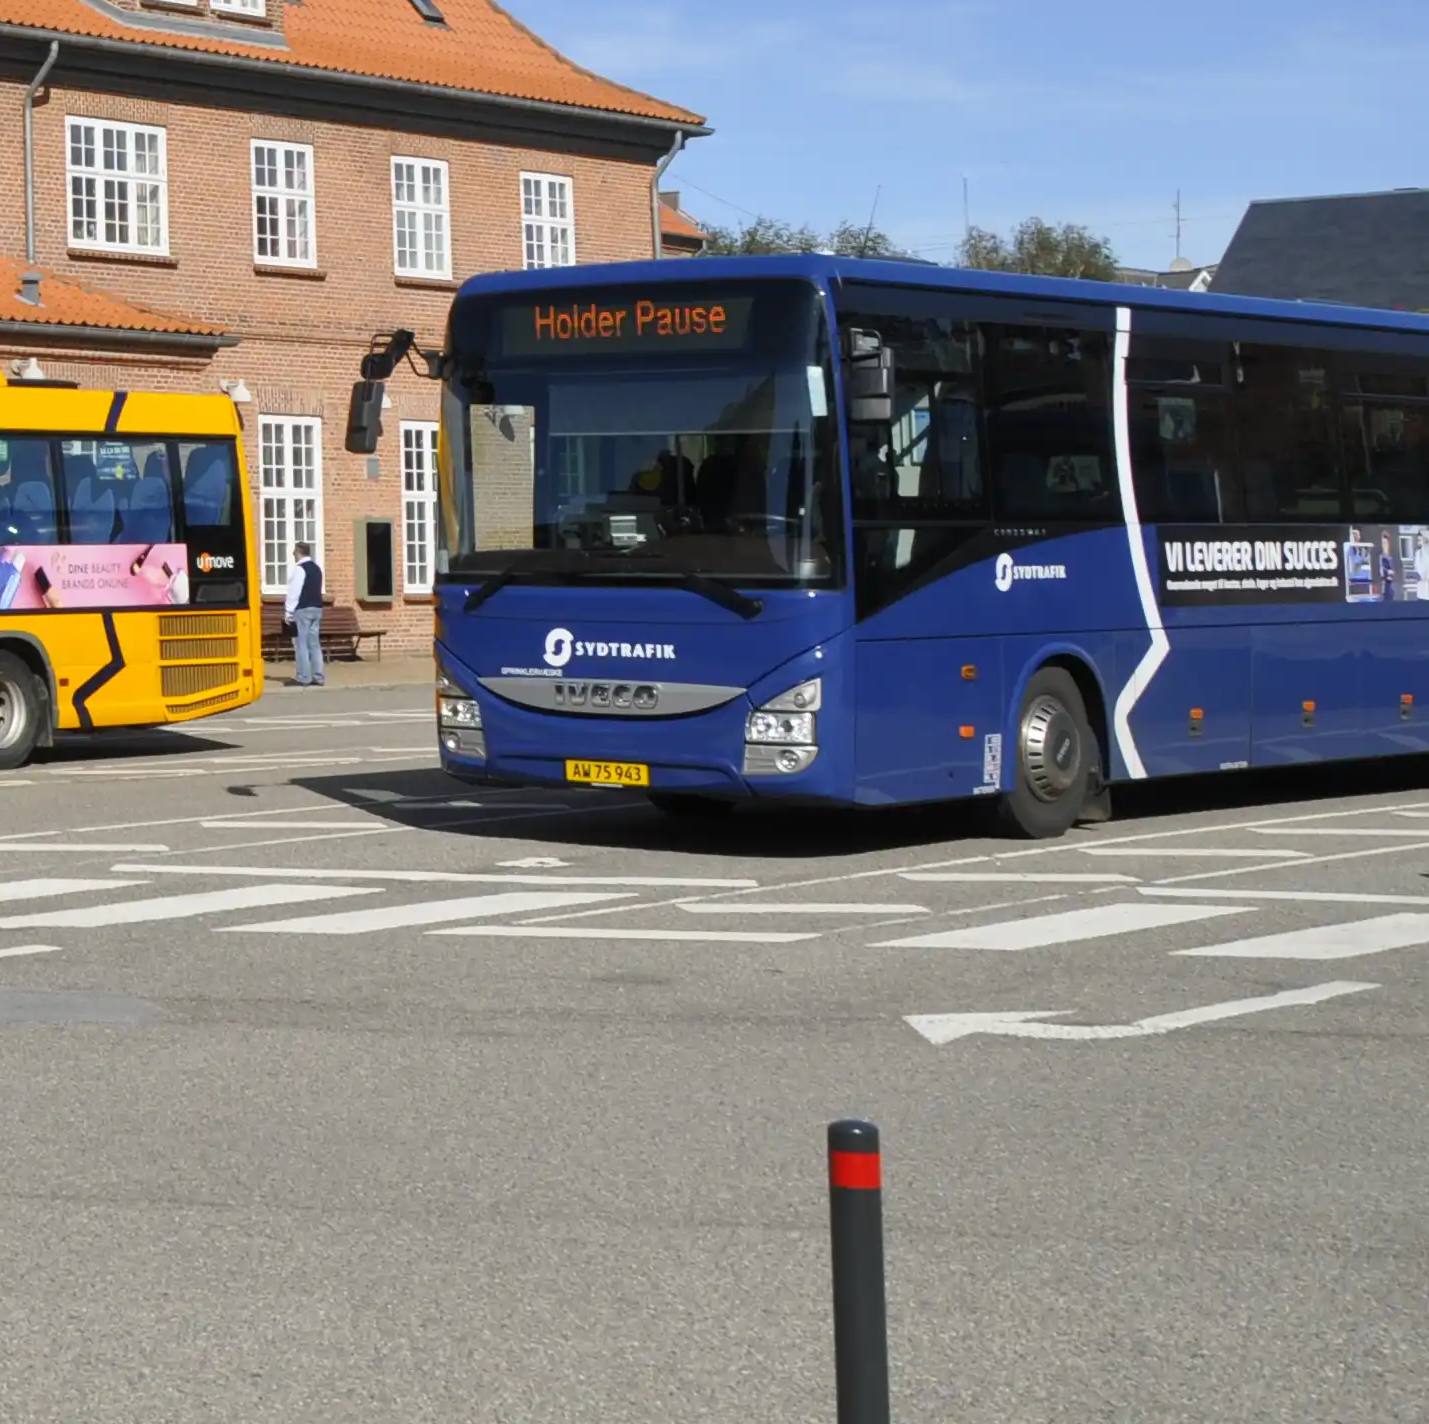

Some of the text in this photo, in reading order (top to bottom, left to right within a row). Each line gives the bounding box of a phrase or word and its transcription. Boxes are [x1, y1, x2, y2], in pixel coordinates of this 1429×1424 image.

[534, 300, 727, 340] Holder Pause
[1165, 540, 1339, 572] VI LEVERER DIN SUCCES
[68, 562, 121, 574] DINE BEAUTY
[1013, 565, 1067, 579] SYDTRAFIK
[62, 576, 130, 590] BRANDS ONLINE
[575, 641, 677, 659] SYDTRAFIK
[554, 681, 660, 709] IVECO
[573, 763, 641, 781] AW 75 943
